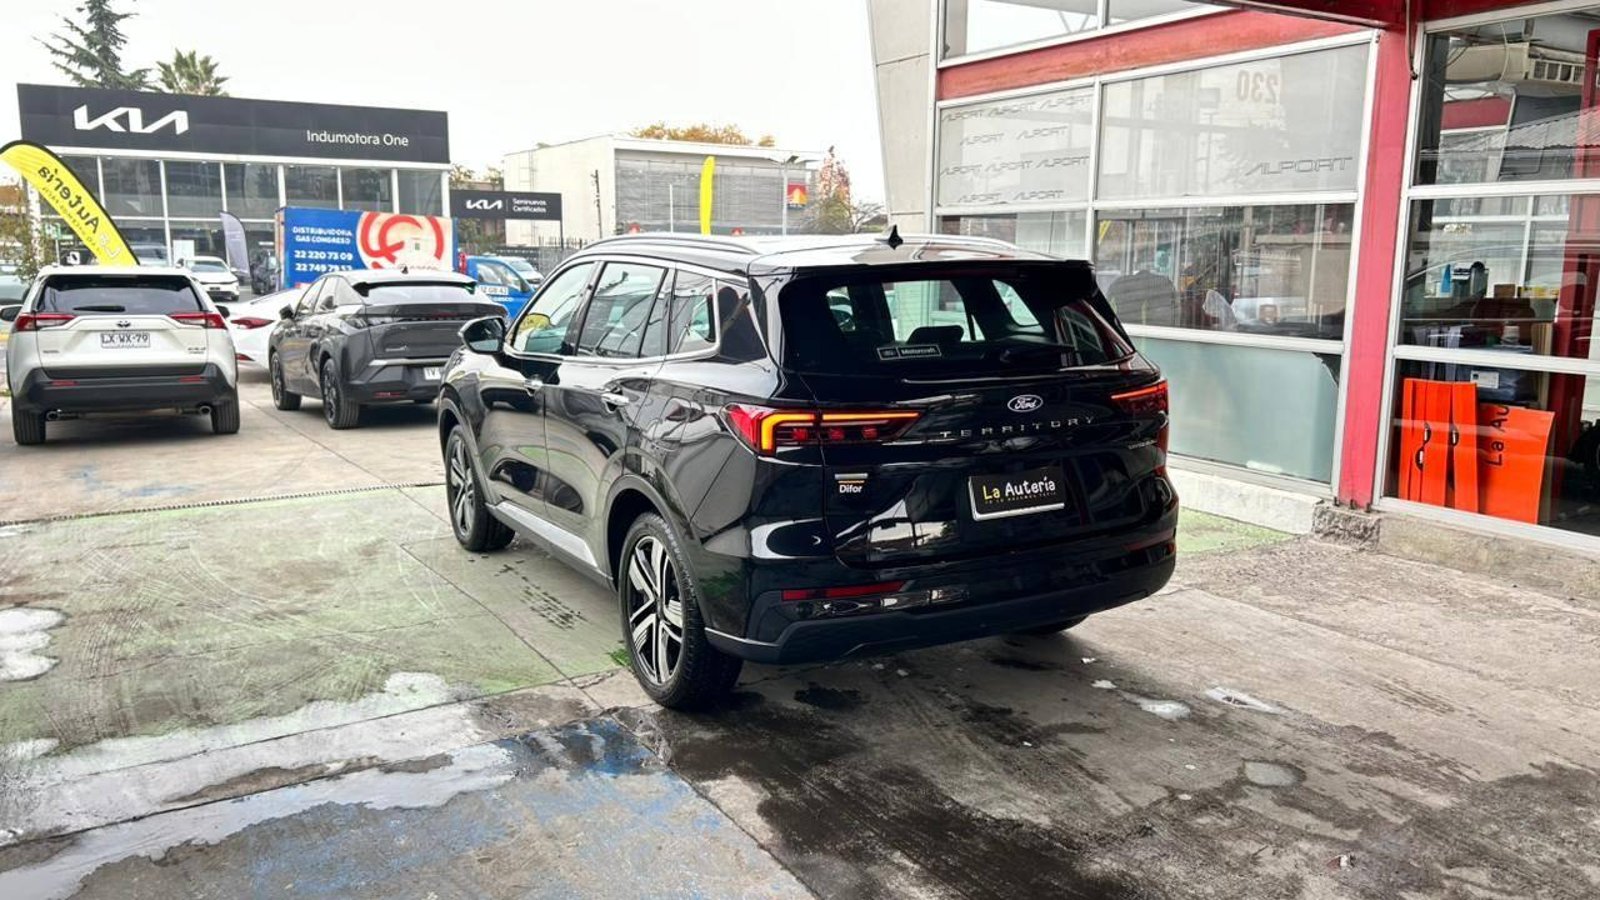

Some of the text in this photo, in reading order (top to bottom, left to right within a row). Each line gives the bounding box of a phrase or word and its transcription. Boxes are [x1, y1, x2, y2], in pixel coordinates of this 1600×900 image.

[74, 104, 188, 135] KIA
[306, 129, 409, 146] Indumotora One
[465, 199, 503, 210] KIA
[511, 198, 547, 207] Seminuevos
[511, 205, 547, 214] Certificados
[292, 226, 353, 237] DISTRIBUIDORA
[295, 234, 351, 245] GAS CONGRESO
[295, 249, 306, 259] 22
[307, 250, 326, 259] 220
[340, 252, 353, 261] 09
[295, 263, 307, 271] 22
[940, 415, 1095, 439] TERRITORY
[1484, 440, 1504, 467] La
[839, 484, 863, 494] Difor
[982, 484, 1001, 500] La
[1005, 475, 1056, 497] Autería
